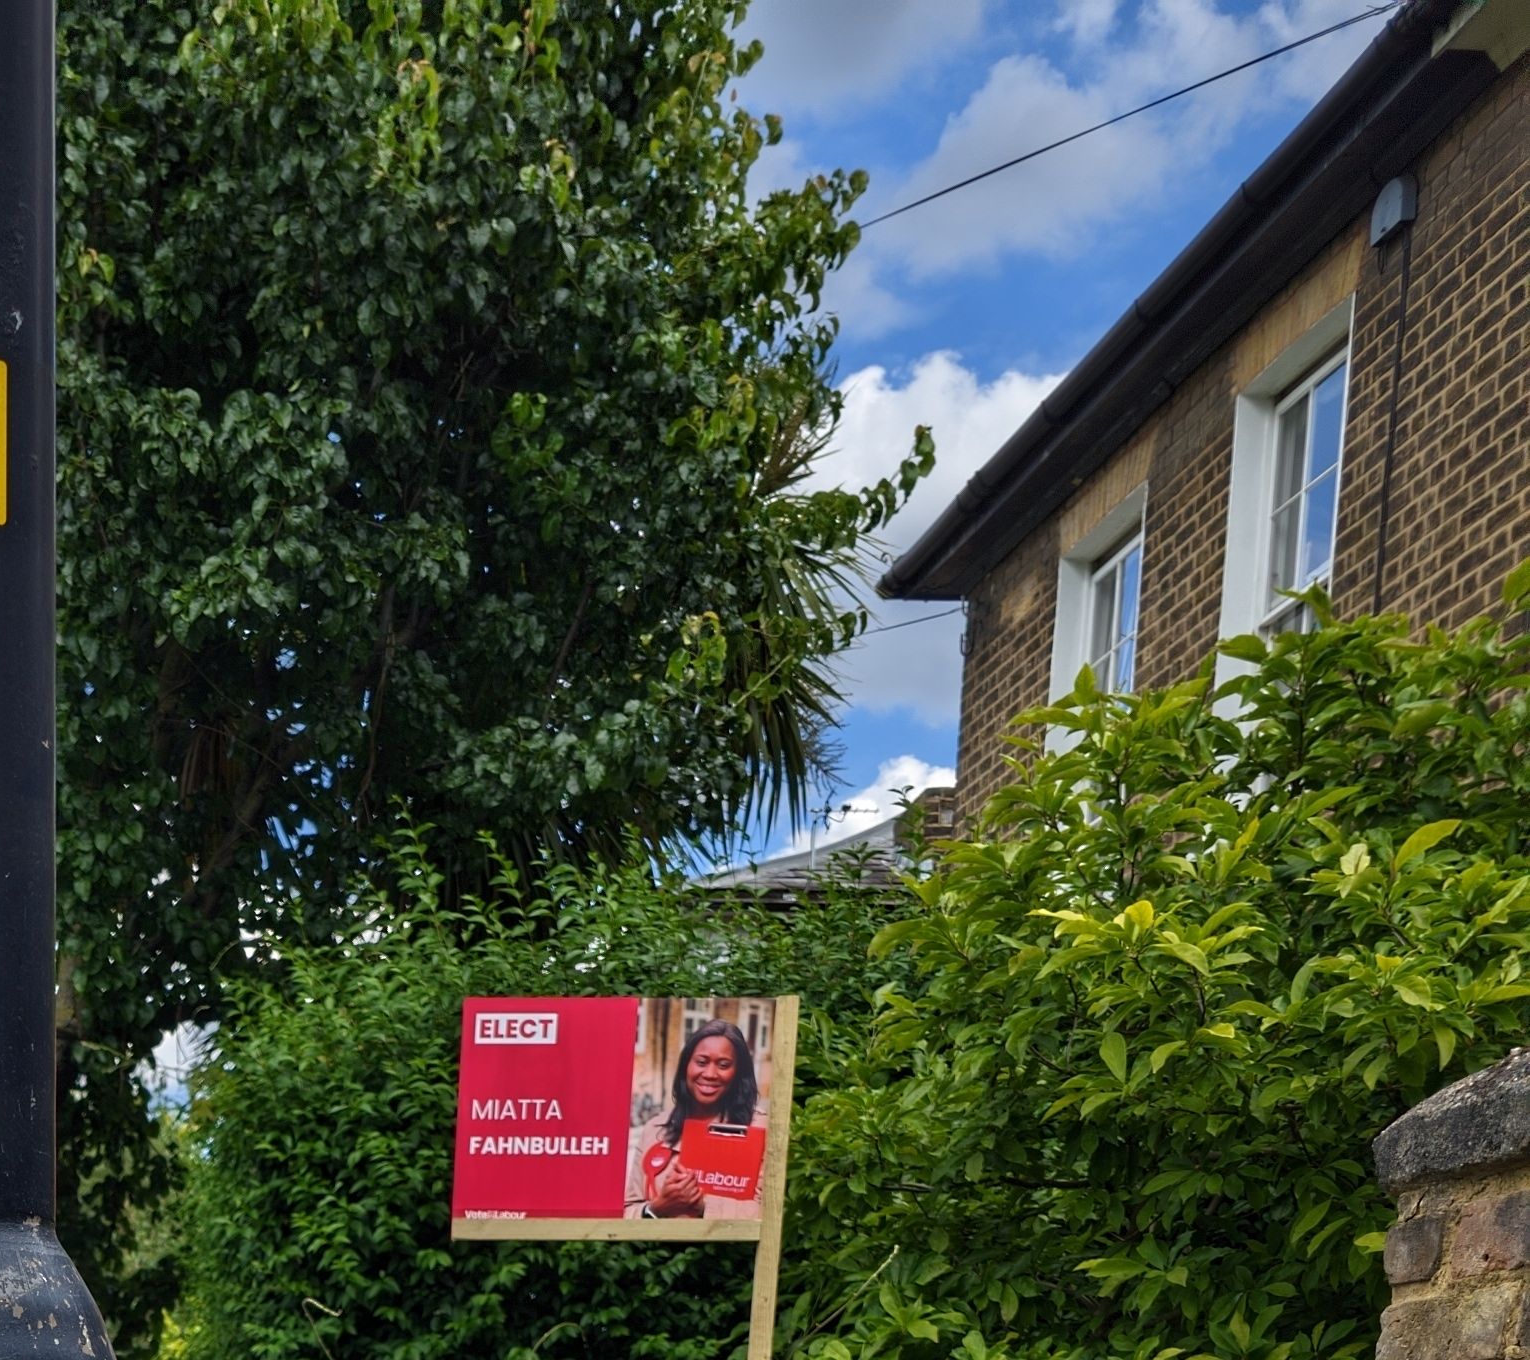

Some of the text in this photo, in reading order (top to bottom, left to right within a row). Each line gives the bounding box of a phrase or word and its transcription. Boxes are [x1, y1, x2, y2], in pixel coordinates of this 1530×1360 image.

[479, 1019, 554, 1039] ELECT
[471, 1099, 563, 1121] MIATTA
[469, 1137, 609, 1155] FAHNBULLEH
[698, 1170, 750, 1187] Labour
